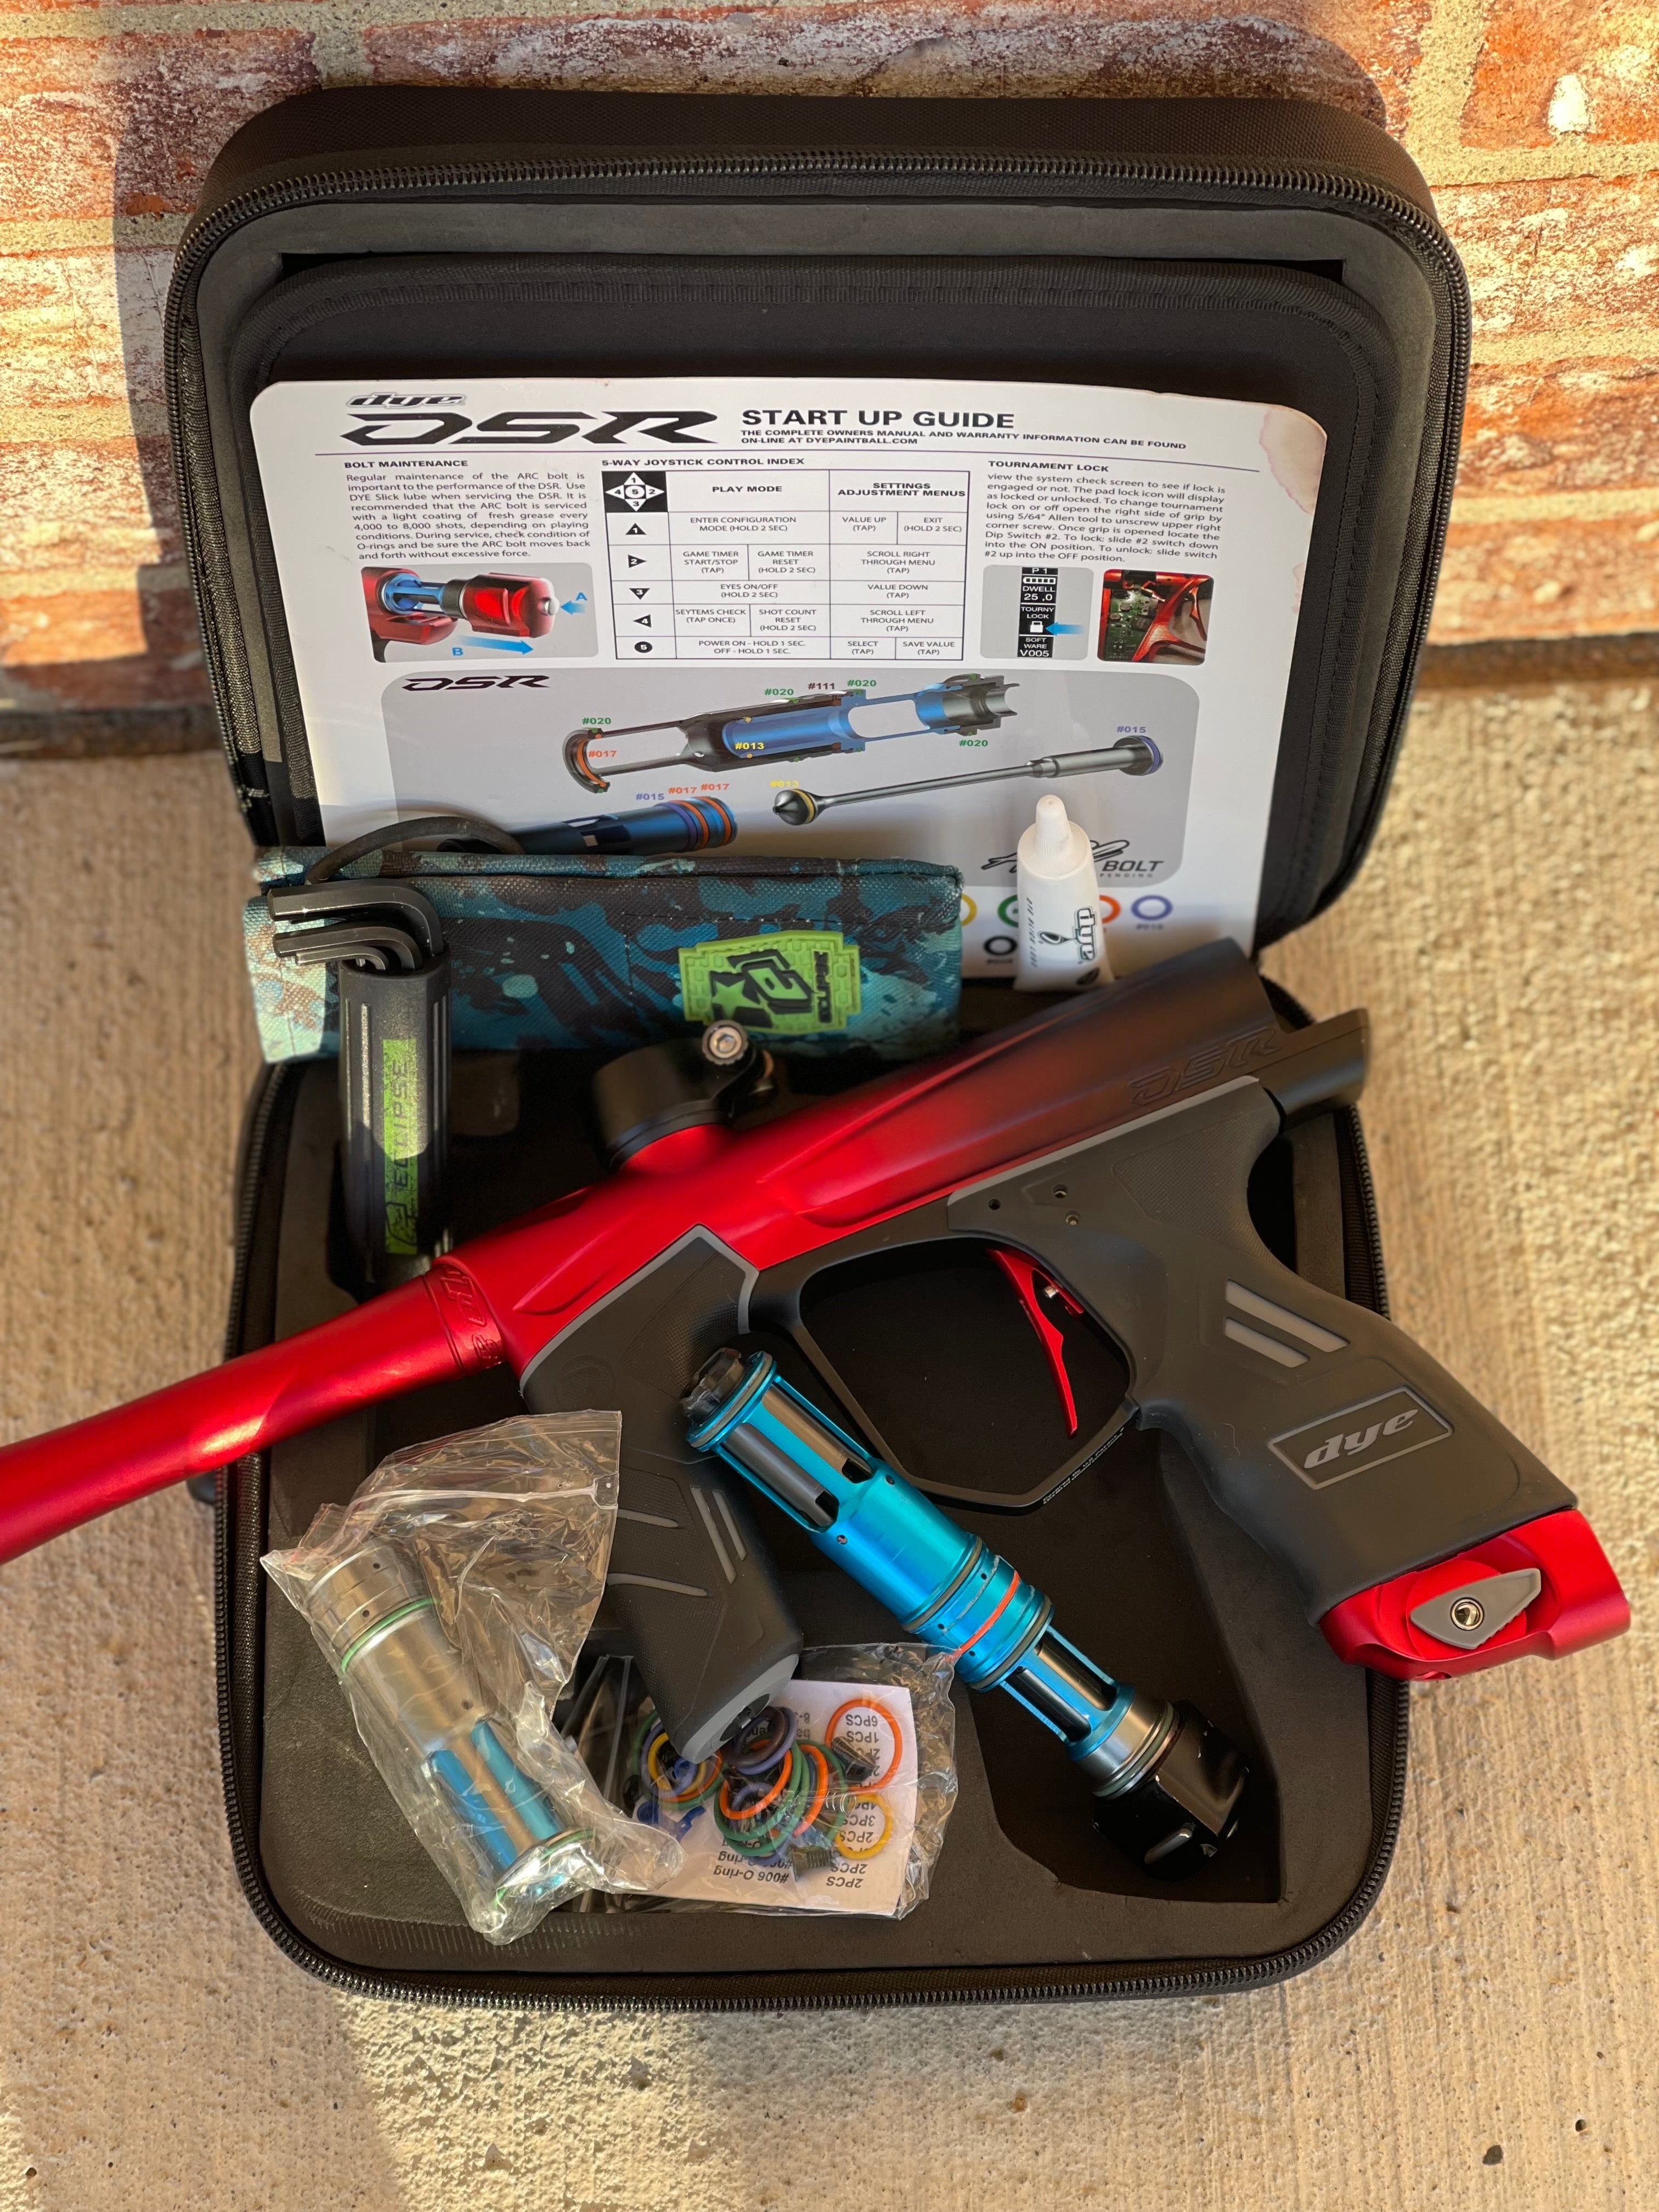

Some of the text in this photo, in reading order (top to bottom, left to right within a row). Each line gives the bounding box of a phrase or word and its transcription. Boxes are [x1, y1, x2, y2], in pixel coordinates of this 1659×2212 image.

[347, 393, 466, 408] dye
[742, 409, 1014, 428] START UP GUIDE
[340, 411, 718, 445] DSR
[1023, 434, 1100, 443] INFORMATION
[1147, 441, 1187, 449] FOUND
[988, 460, 1109, 472] TOURNAMENT LOCK
[346, 473, 387, 483] Regular
[348, 484, 401, 493] important
[436, 482, 504, 492] performance
[1076, 476, 1107, 485] check
[1193, 484, 1215, 493] lock
[465, 492, 512, 501] servicing
[987, 484, 1034, 492] engaged
[1118, 488, 1139, 496] lock
[1142, 490, 1164, 498] icon
[1187, 493, 1225, 505] display
[575, 592, 588, 601] A
[452, 647, 464, 656] B
[402, 675, 550, 691] DSR
[1116, 725, 1146, 733] #015
[735, 742, 764, 750] #013
[959, 739, 988, 747] #020
[1102, 861, 1164, 872] BOLT
[1075, 907, 1096, 961] dye
[1128, 1026, 1282, 1107] DSR
[392, 1060, 410, 1189] ECLIPSE
[1304, 1409, 1418, 1469] dye
[845, 1714, 878, 1727] 6PCS
[847, 1731, 879, 1743] 1PCS
[839, 1831, 874, 1843] 2PCS
[713, 1865, 789, 1883] #006 O-ring
[826, 1876, 864, 1888] 2PCS
